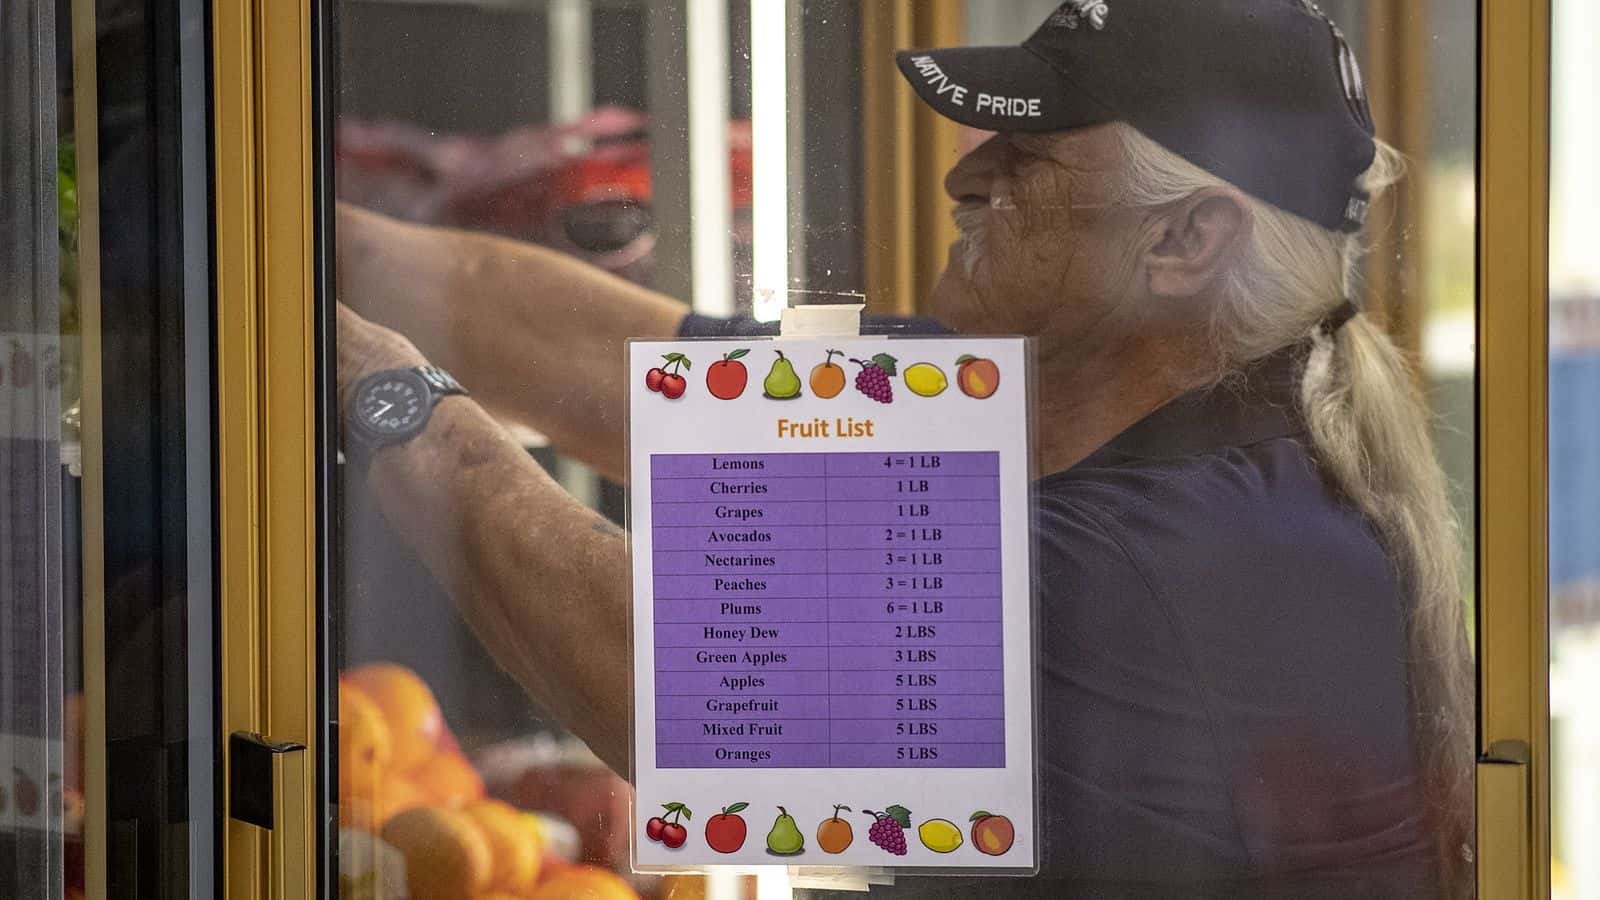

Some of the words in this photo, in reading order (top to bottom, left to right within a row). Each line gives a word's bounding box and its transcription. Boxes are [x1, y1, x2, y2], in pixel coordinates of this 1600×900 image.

[911, 55, 968, 106] NATIVE
[976, 93, 1041, 117] PRIDE
[777, 418, 830, 438] Fruit
[836, 417, 875, 438] List
[712, 457, 765, 470] Lemons
[883, 455, 892, 469] 4
[909, 455, 915, 469] 1
[920, 455, 941, 469] LB
[709, 481, 768, 495] Cherries
[897, 480, 903, 493] 1
[909, 479, 929, 493] LB
[714, 505, 764, 522] Grapes
[898, 504, 904, 517] 1
[909, 503, 930, 517] LB
[707, 529, 772, 543] Avocados
[885, 528, 893, 541] 2
[911, 528, 916, 541] 1
[922, 528, 942, 541] LB
[704, 553, 776, 567] Nectarines
[885, 552, 894, 566] 3
[911, 553, 917, 566] 1
[922, 552, 943, 566] LB
[714, 578, 767, 591] Peaches
[885, 577, 894, 590] 3
[911, 577, 917, 590] 1
[922, 576, 943, 590] LB
[720, 602, 762, 615] Plums
[886, 601, 895, 614] 6
[912, 601, 917, 614] 1
[923, 600, 944, 614] LB
[703, 626, 747, 643] Honey
[750, 626, 780, 639] Dew
[895, 625, 903, 639] 2
[907, 625, 936, 639] LBS
[695, 650, 737, 664] Green
[741, 650, 788, 667] Apples
[895, 649, 903, 663] 3
[907, 649, 937, 663] LBS
[719, 674, 766, 691] Apples
[895, 674, 904, 687] 5
[907, 673, 937, 687] LBS
[705, 698, 779, 715] Grapefruit
[895, 698, 905, 711] 5
[908, 698, 937, 711] LBS
[702, 722, 745, 737] Mixed
[748, 722, 784, 736] Fruit
[896, 722, 905, 736] 5
[908, 722, 938, 736] LBS
[714, 747, 774, 764] Oranges
[896, 747, 905, 760] 5
[908, 746, 939, 760] LBS
